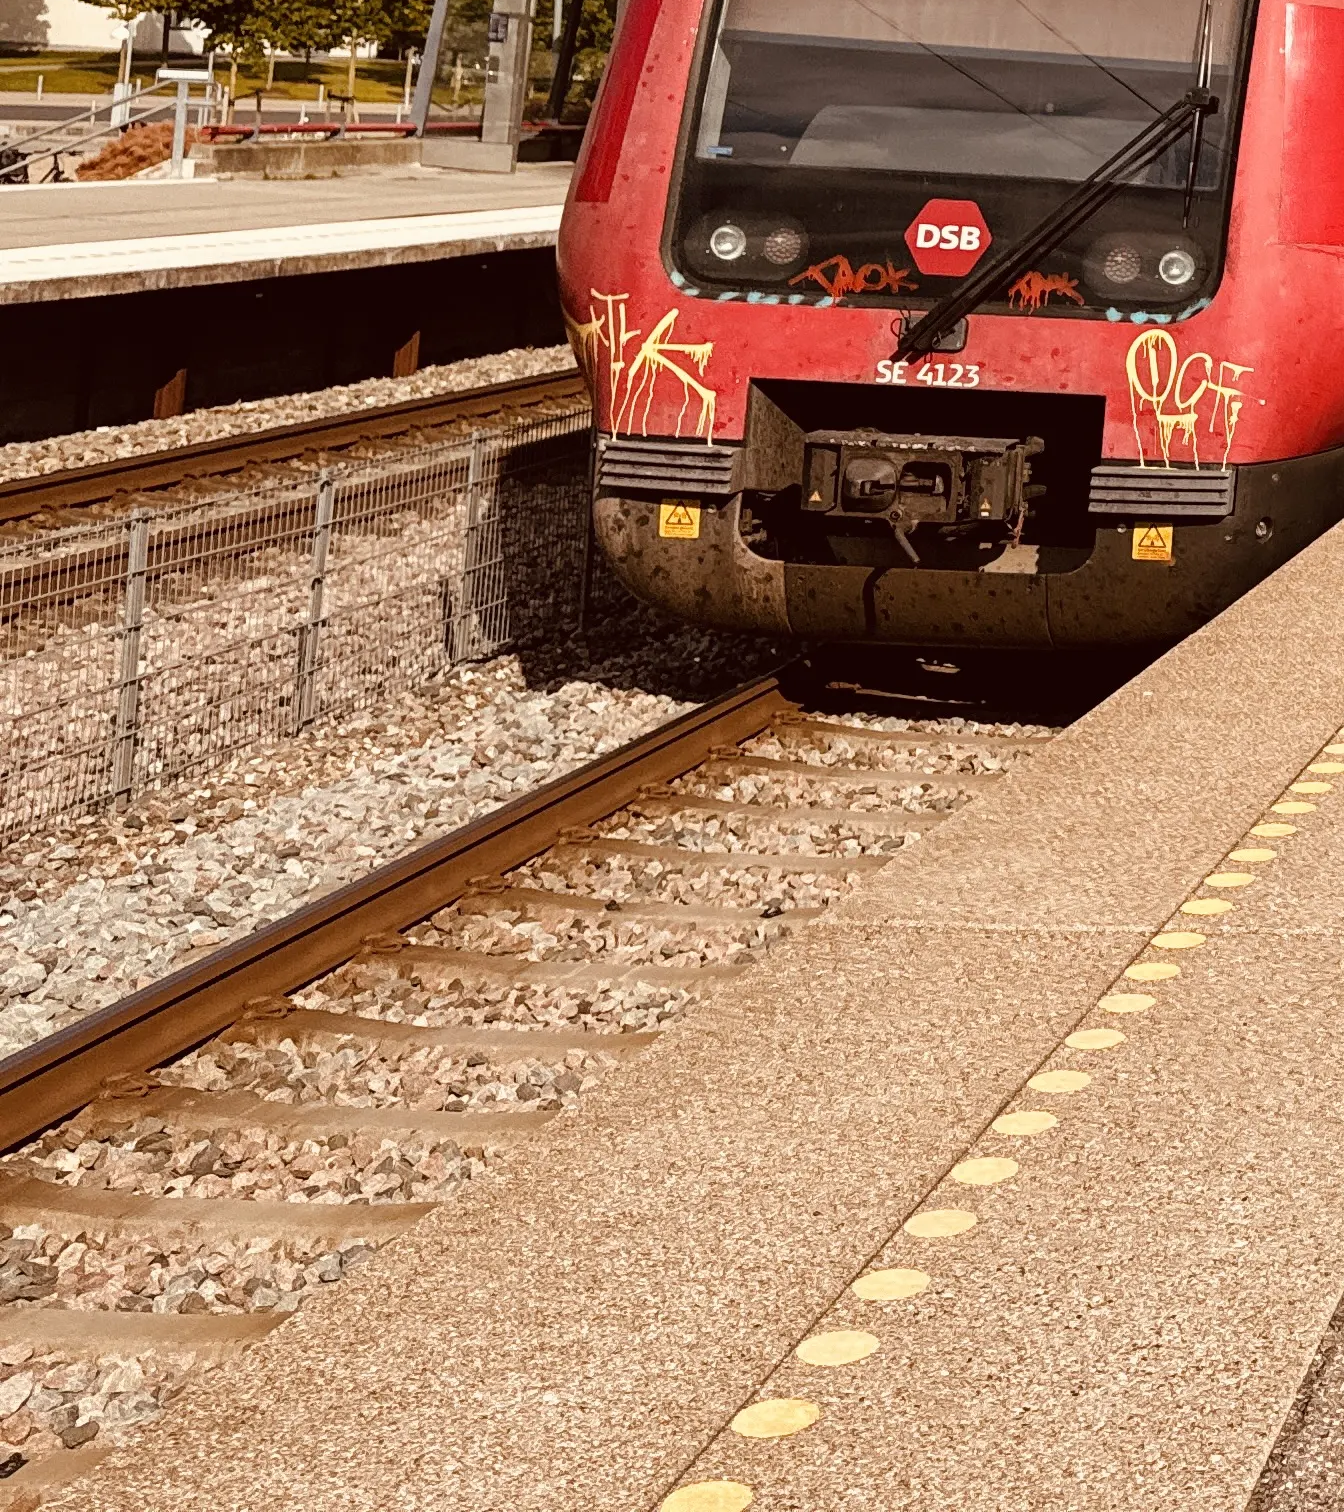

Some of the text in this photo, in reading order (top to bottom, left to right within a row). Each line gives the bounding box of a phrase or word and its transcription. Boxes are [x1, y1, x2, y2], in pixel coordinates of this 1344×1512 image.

[915, 223, 981, 251] DSB
[875, 359, 980, 388] SE 4123
